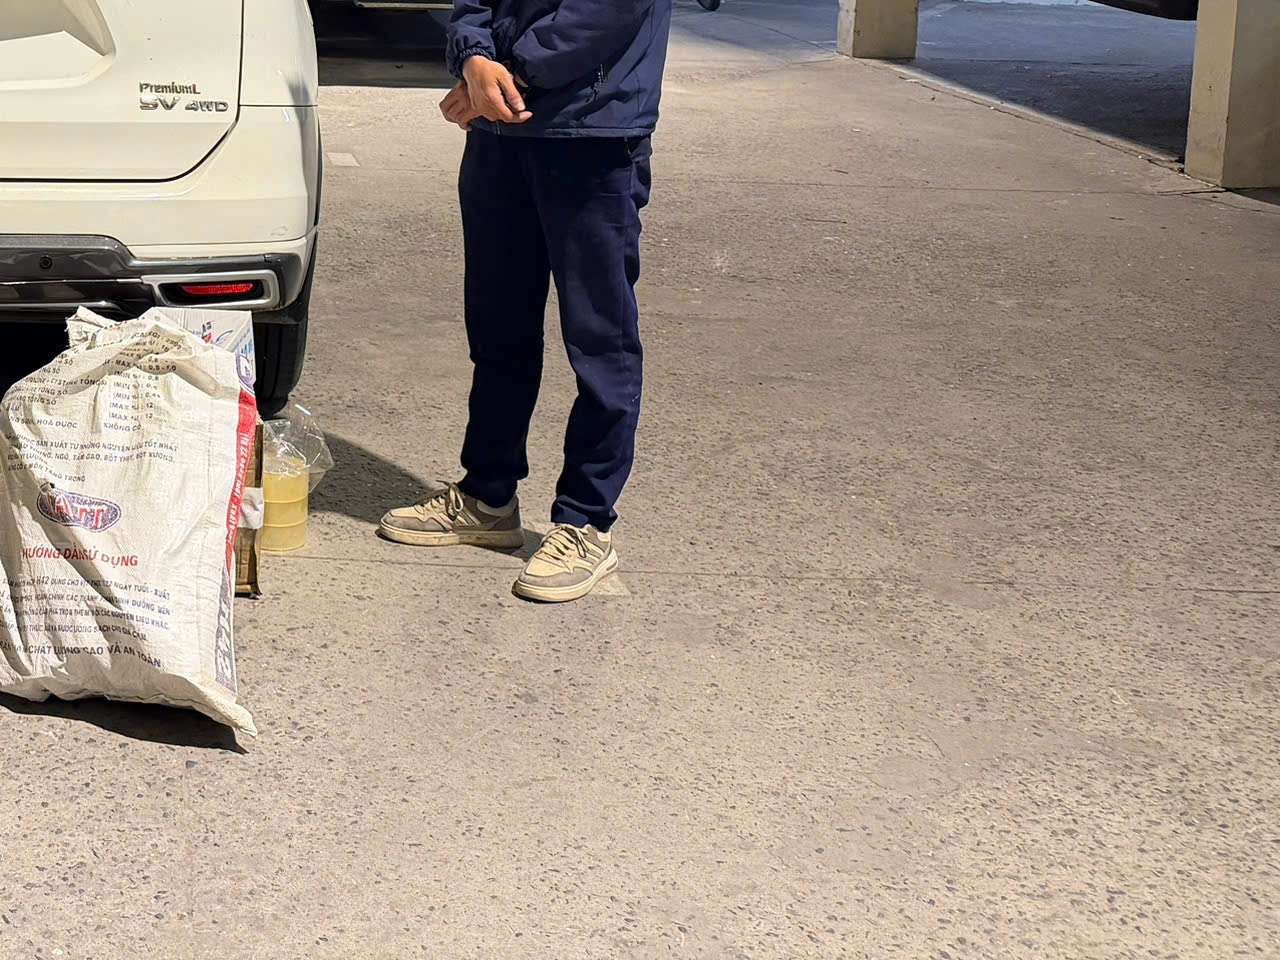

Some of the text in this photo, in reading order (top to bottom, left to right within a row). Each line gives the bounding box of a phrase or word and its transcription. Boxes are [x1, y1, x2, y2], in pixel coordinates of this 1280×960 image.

[140, 95, 229, 112] SV 4WD
[23, 544, 61, 560] HƯỚNG
[101, 553, 139, 568] DỤNG
[123, 646, 136, 655] AN
